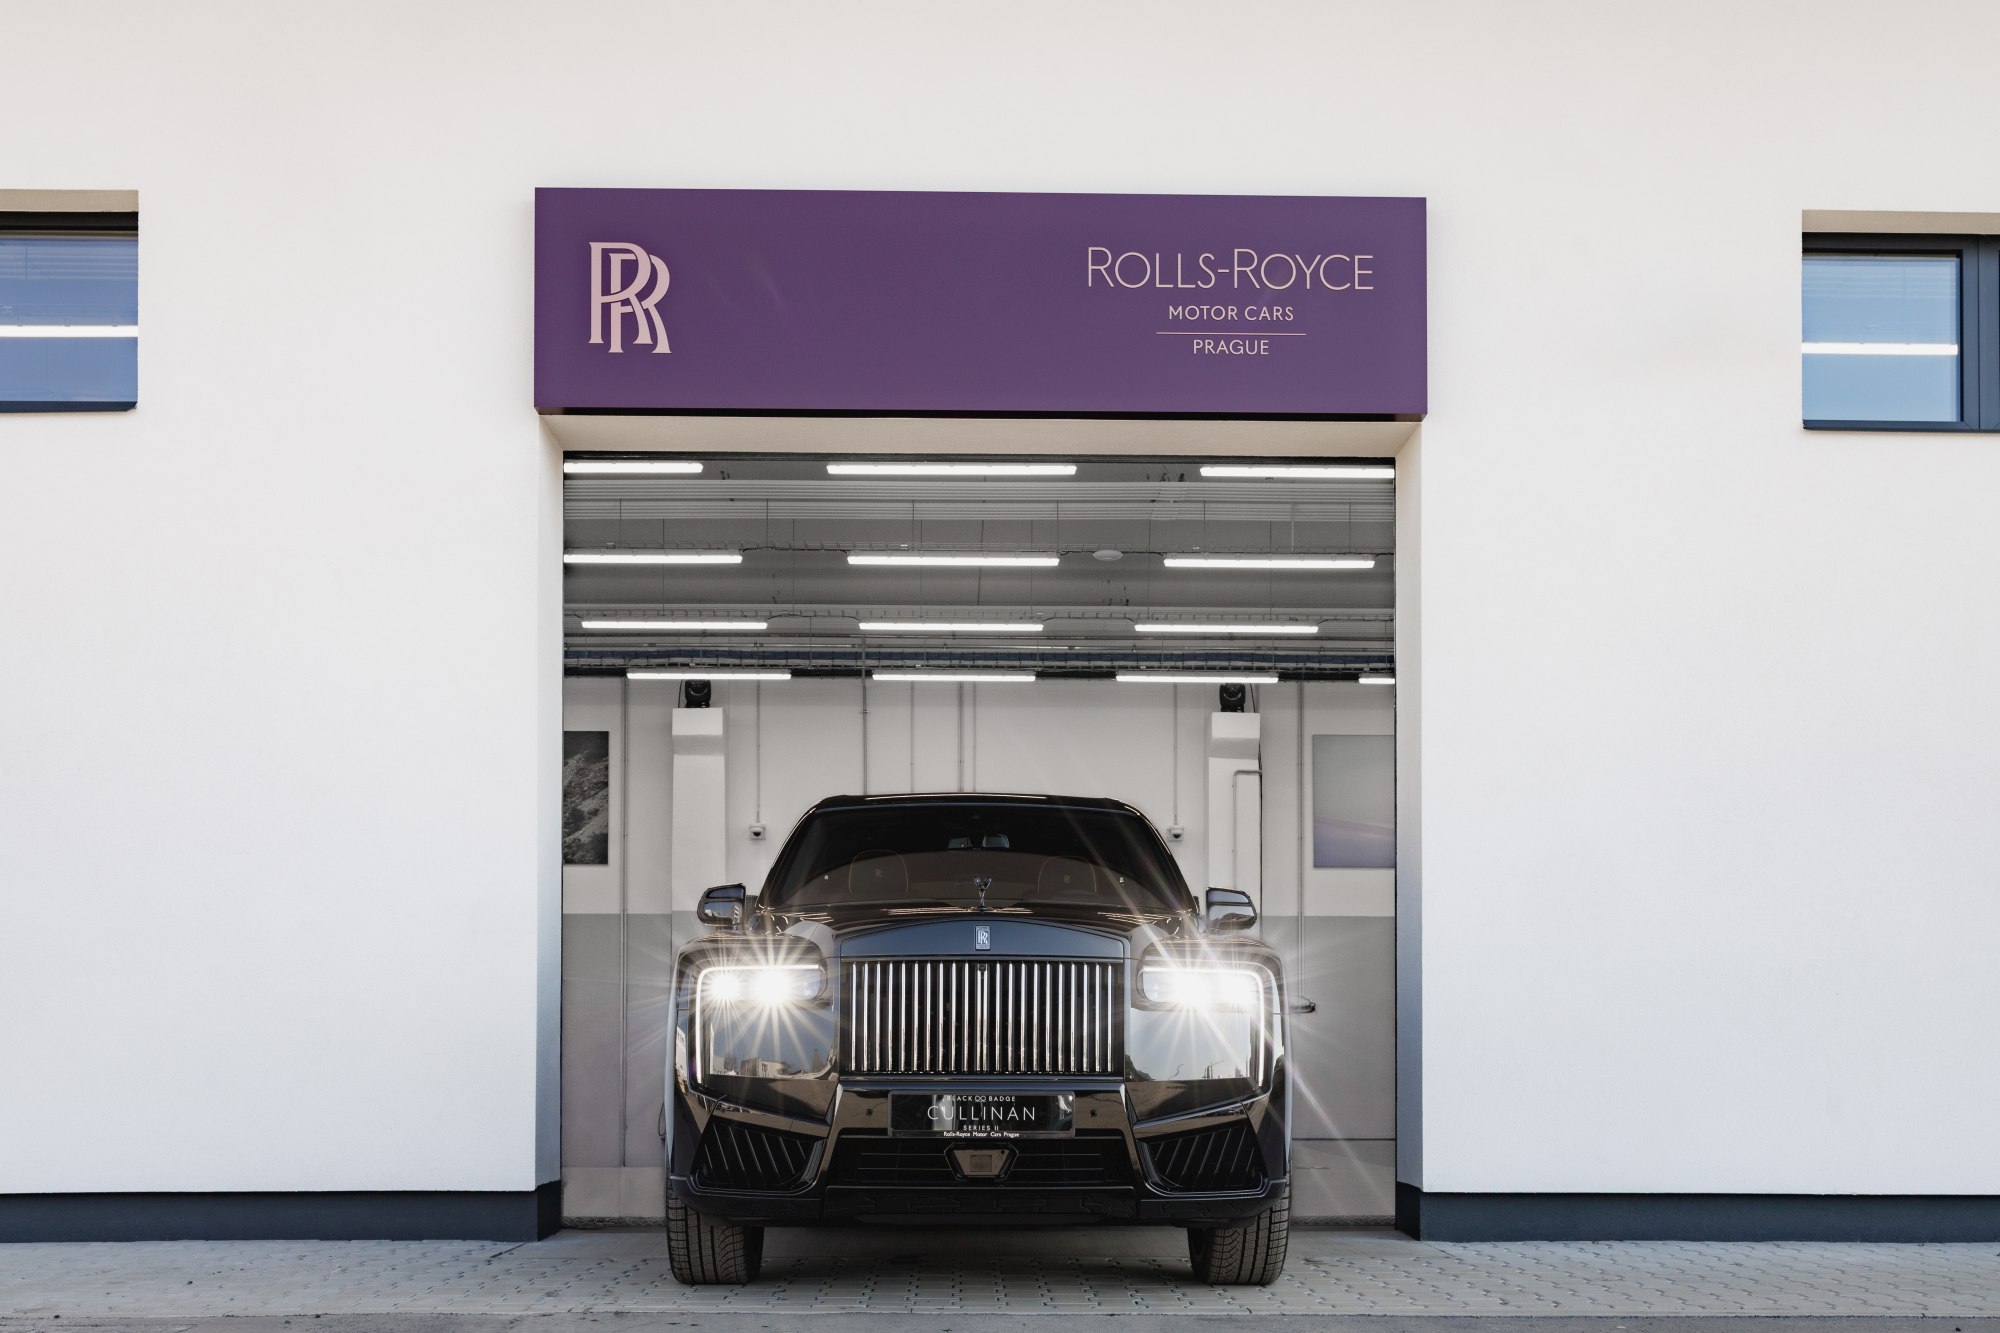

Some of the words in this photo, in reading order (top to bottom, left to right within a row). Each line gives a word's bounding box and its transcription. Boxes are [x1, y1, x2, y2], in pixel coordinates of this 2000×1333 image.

[588, 242, 672, 354] RR
[1169, 306, 1238, 320] MOTOR
[1244, 307, 1294, 321] CARS
[1193, 340, 1269, 354] PRAGUE
[927, 1106, 1035, 1120] CULLINAN
